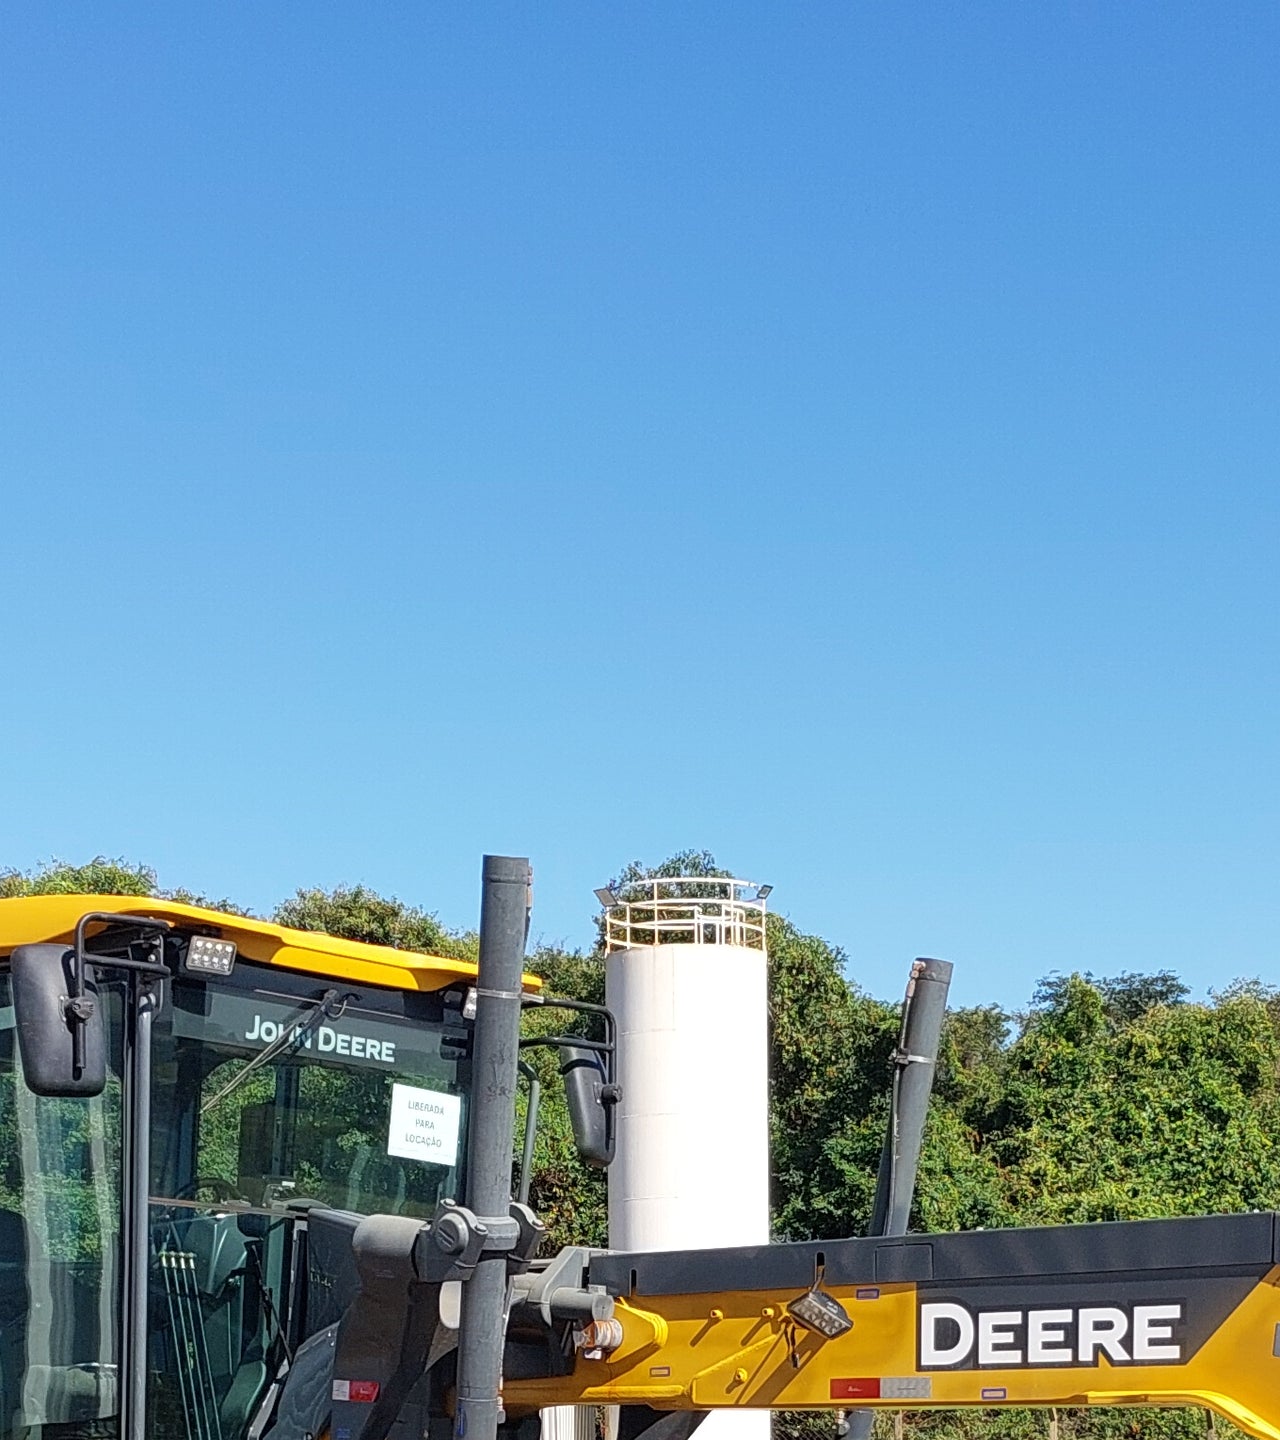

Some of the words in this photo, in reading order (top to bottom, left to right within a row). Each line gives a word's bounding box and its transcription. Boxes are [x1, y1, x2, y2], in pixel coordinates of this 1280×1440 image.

[318, 1026, 396, 1063] DEERE
[408, 1100, 444, 1116] LIBERADA
[415, 1119, 435, 1131] PARA
[405, 1132, 442, 1149] LOCAÇÃO
[921, 1302, 1181, 1366] DEERE
